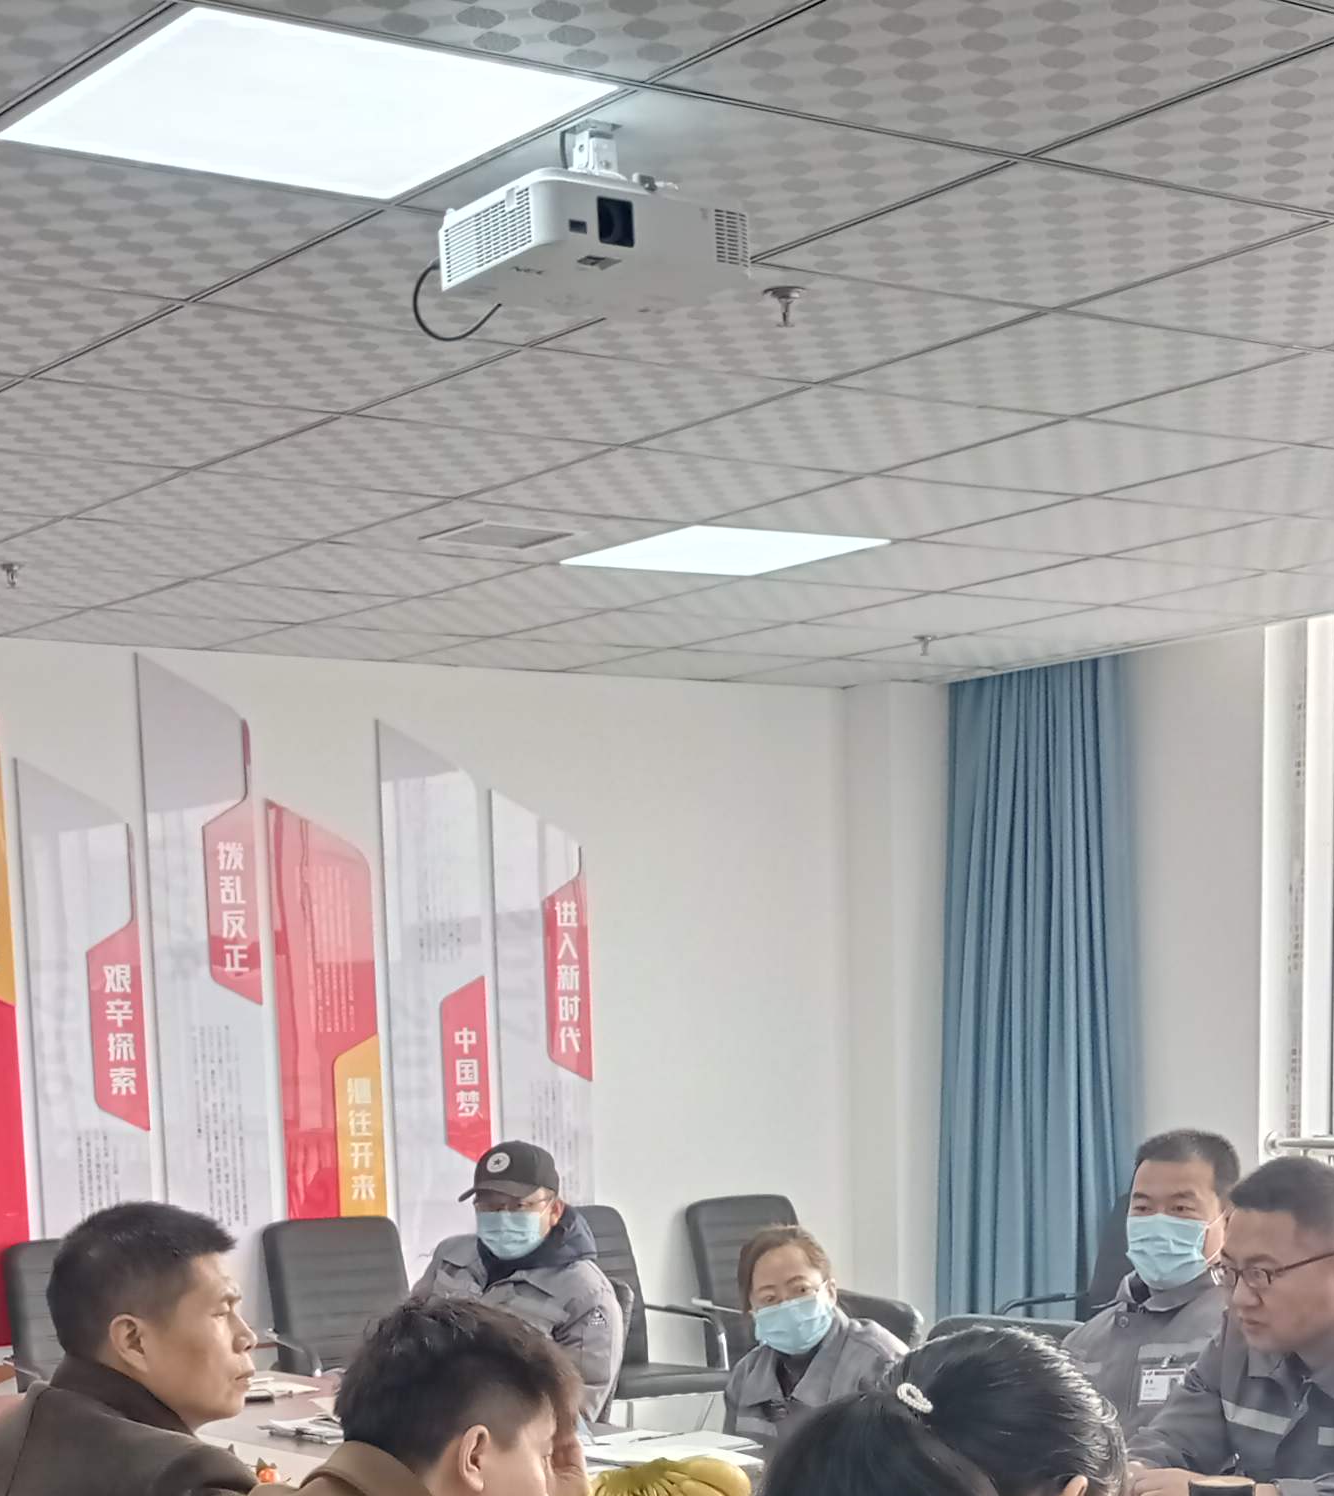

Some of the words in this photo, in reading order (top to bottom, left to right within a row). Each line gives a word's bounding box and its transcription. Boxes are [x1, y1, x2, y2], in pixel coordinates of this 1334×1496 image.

[217, 841, 249, 973] 拨乱反正
[103, 963, 137, 1096] 艰辛探索
[555, 901, 581, 1054] 进入新时代
[454, 1027, 481, 1118] 中国梦
